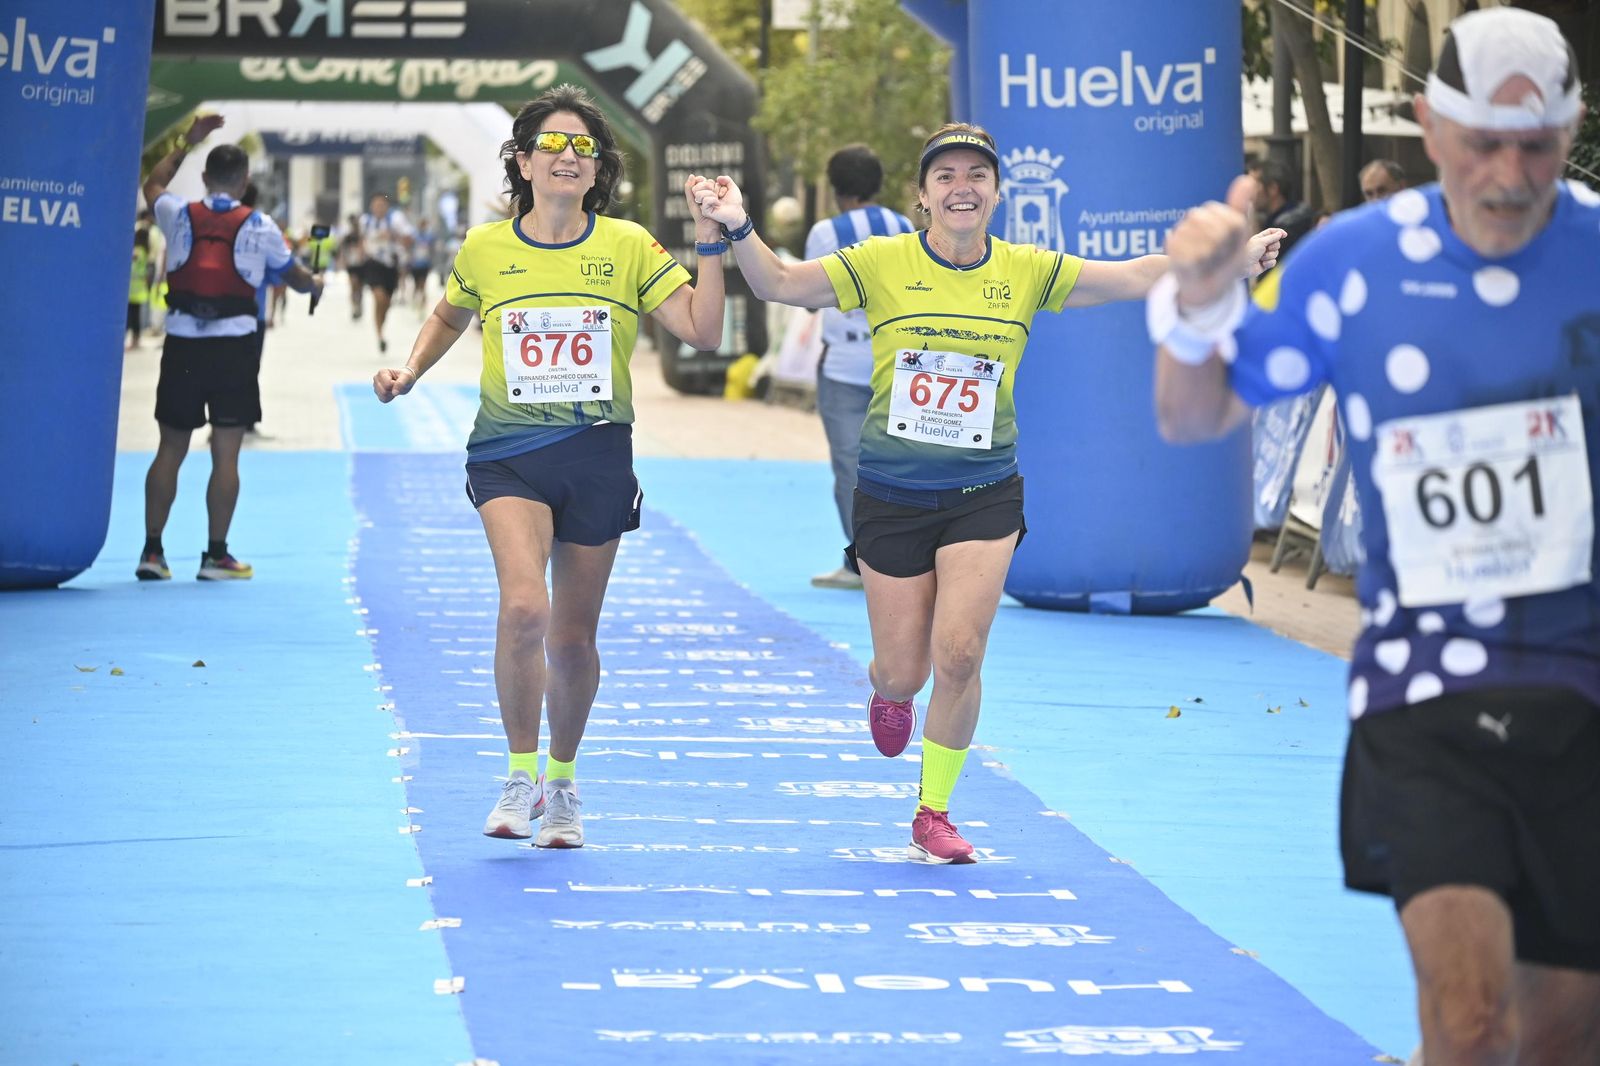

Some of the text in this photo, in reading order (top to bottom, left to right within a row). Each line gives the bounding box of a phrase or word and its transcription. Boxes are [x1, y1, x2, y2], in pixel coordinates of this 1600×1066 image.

[0, 17, 99, 79] lva
[999, 50, 1204, 108] Huelva
[21, 82, 95, 107] original
[1134, 110, 1204, 135] original
[67, 181, 86, 197] de
[581, 254, 612, 262] Runners
[520, 332, 593, 368] 676
[533, 382, 579, 395] Huelva
[909, 372, 980, 413] 675
[915, 421, 960, 439] Huelva
[920, 415, 962, 426] BLANCO GOMEZ
[1416, 453, 1546, 530] 601
